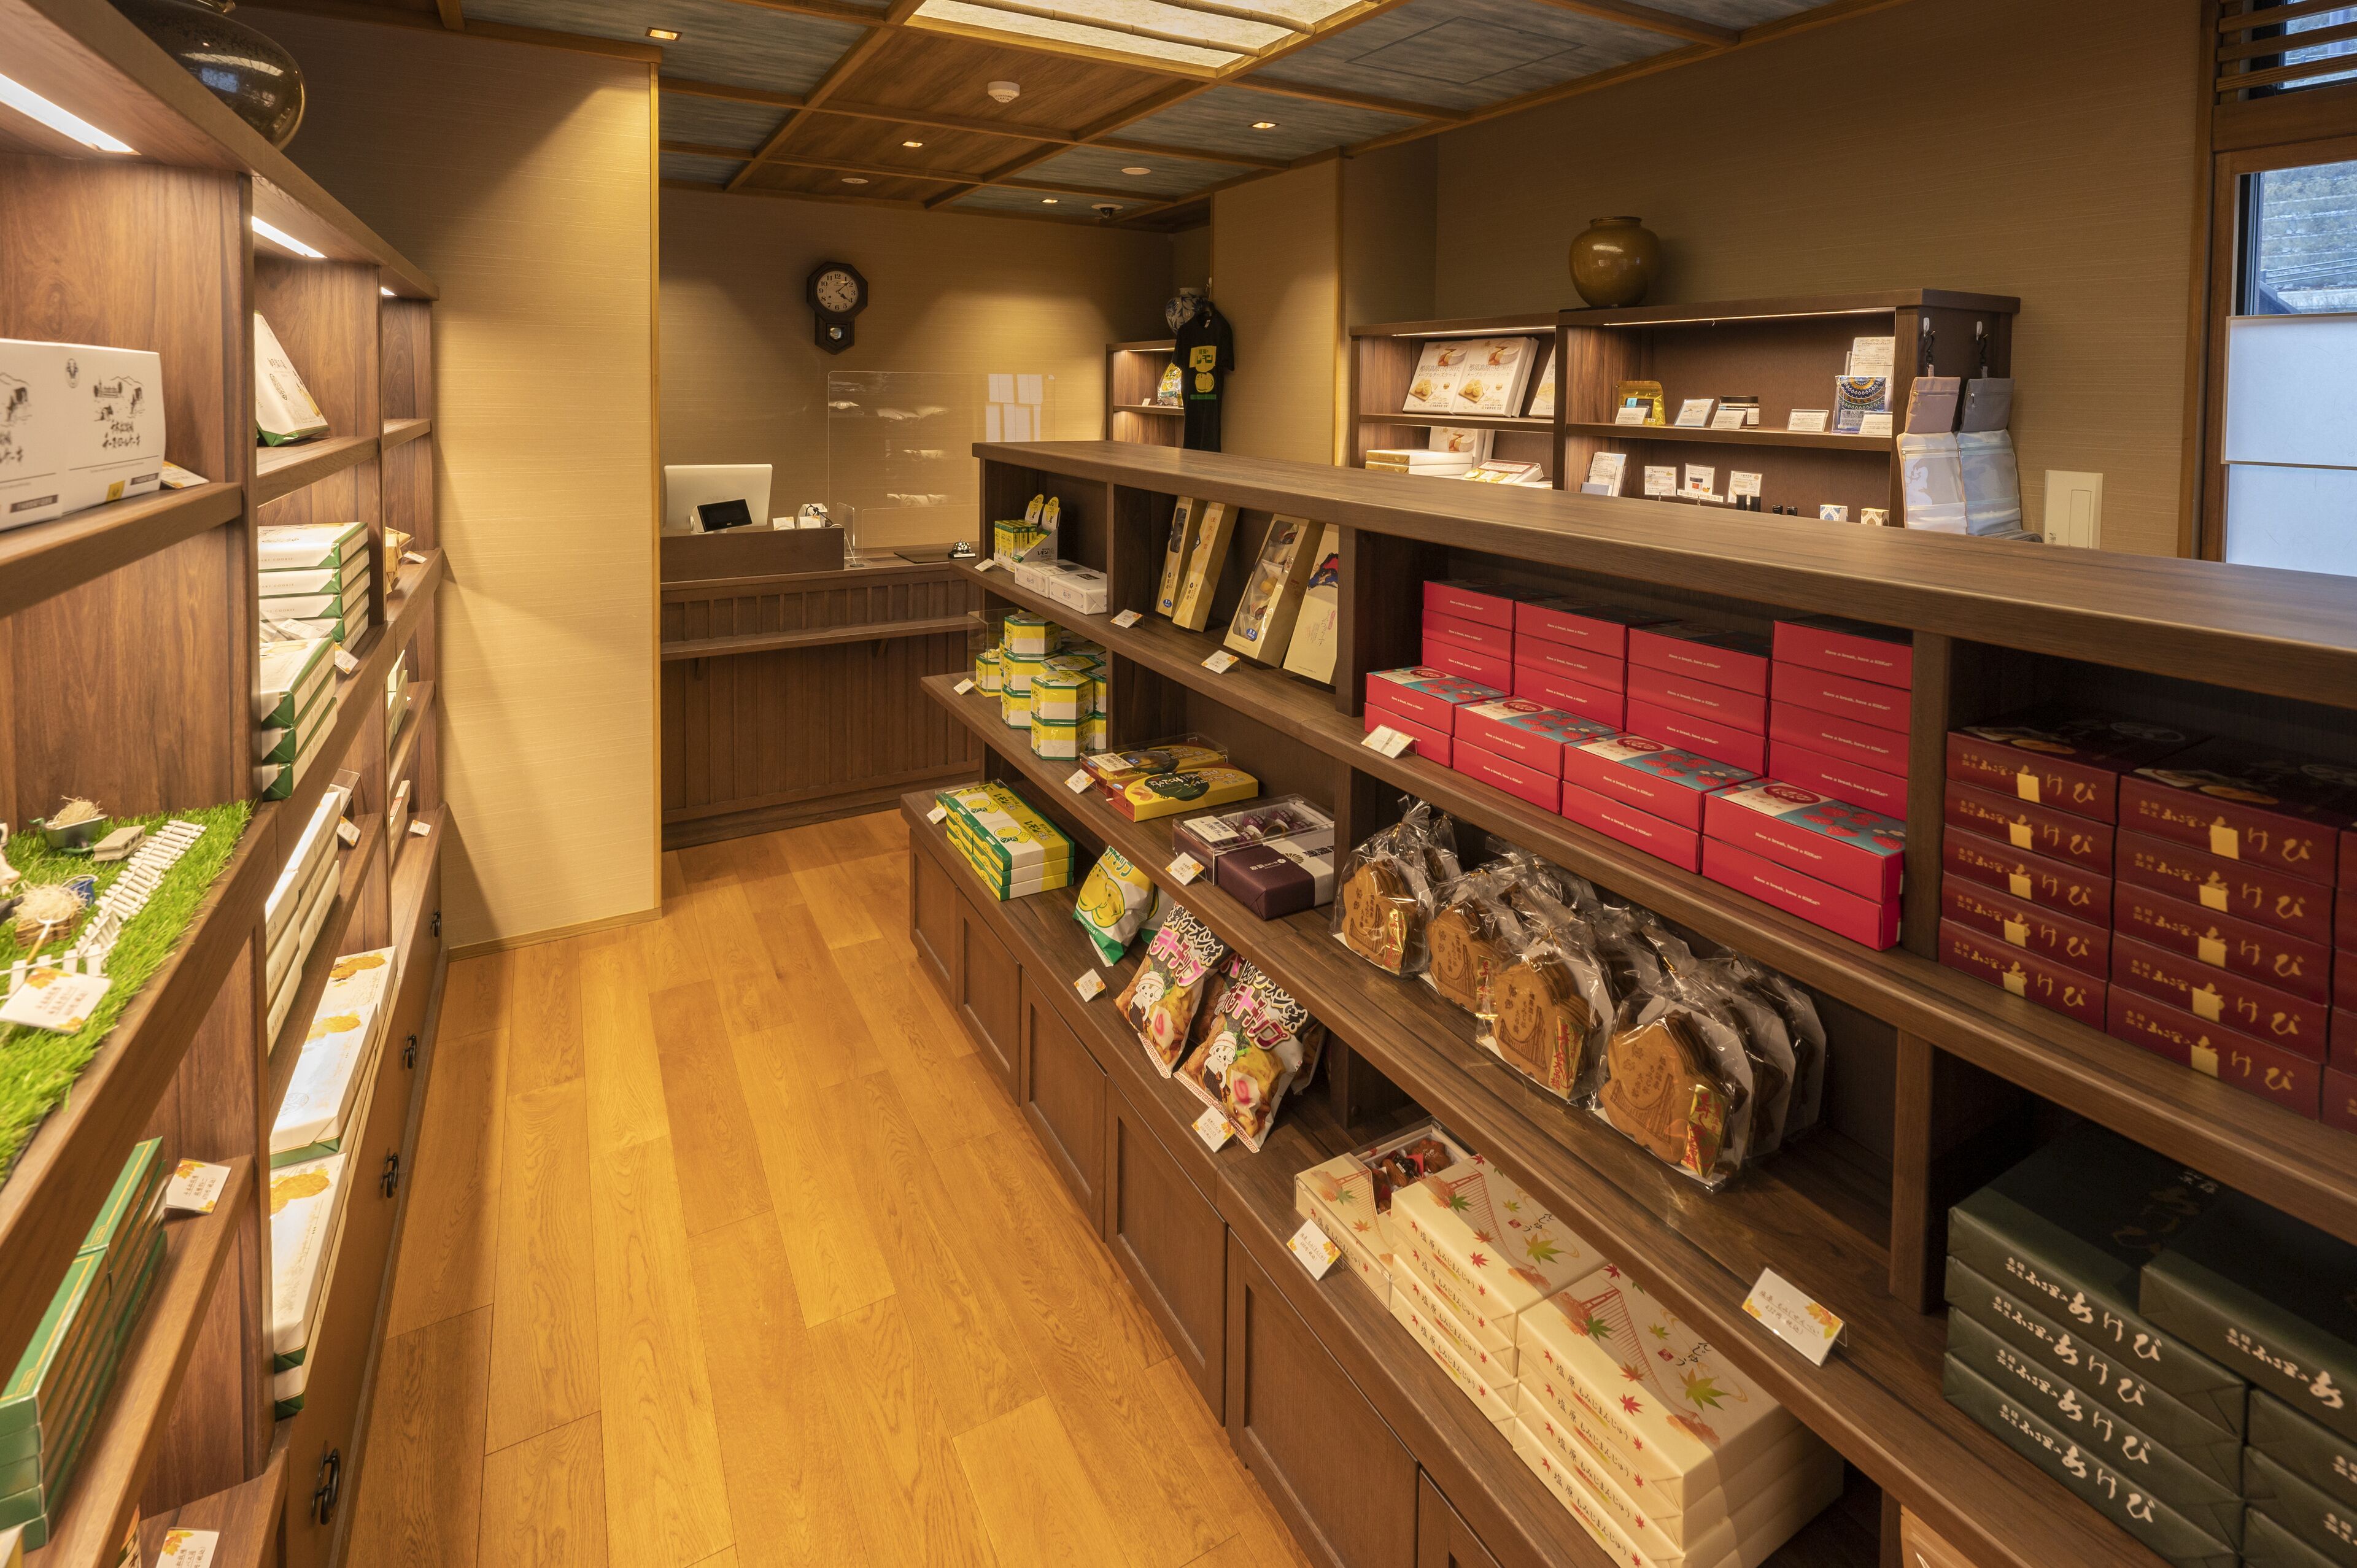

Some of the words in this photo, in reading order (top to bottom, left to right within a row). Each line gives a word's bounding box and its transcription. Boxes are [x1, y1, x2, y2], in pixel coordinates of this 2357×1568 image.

[1196, 355, 1213, 364] レモン
[1420, 1231, 1435, 1251] 塩原
[1436, 1247, 1476, 1289] もみじまんじゅう
[1422, 1260, 1436, 1281] 塩原
[1437, 1278, 1476, 1320] もみじまんじゅう
[1420, 1326, 1435, 1347] 塩原
[1437, 1346, 1476, 1389] もみじまんじゅう
[1422, 1295, 1437, 1316] 塩原
[1438, 1313, 1476, 1356] もみじまんじゅう
[2069, 1291, 2161, 1362] あけび
[1556, 1364, 1576, 1389] 塩原
[1578, 1388, 1629, 1441] もみじまんじゅう
[2054, 1334, 2146, 1407] あけび
[1557, 1399, 1577, 1424] 塩原
[1579, 1423, 1630, 1477] もみじまんじゅう
[2058, 1388, 2150, 1465] あけび
[1557, 1436, 1577, 1462] 塩原
[1580, 1462, 1630, 1518] もみじまんじゅう
[2061, 1445, 2154, 1524] あけび
[1554, 1472, 1574, 1500] 塩原
[1576, 1498, 1627, 1556] もみじまんじゅう
